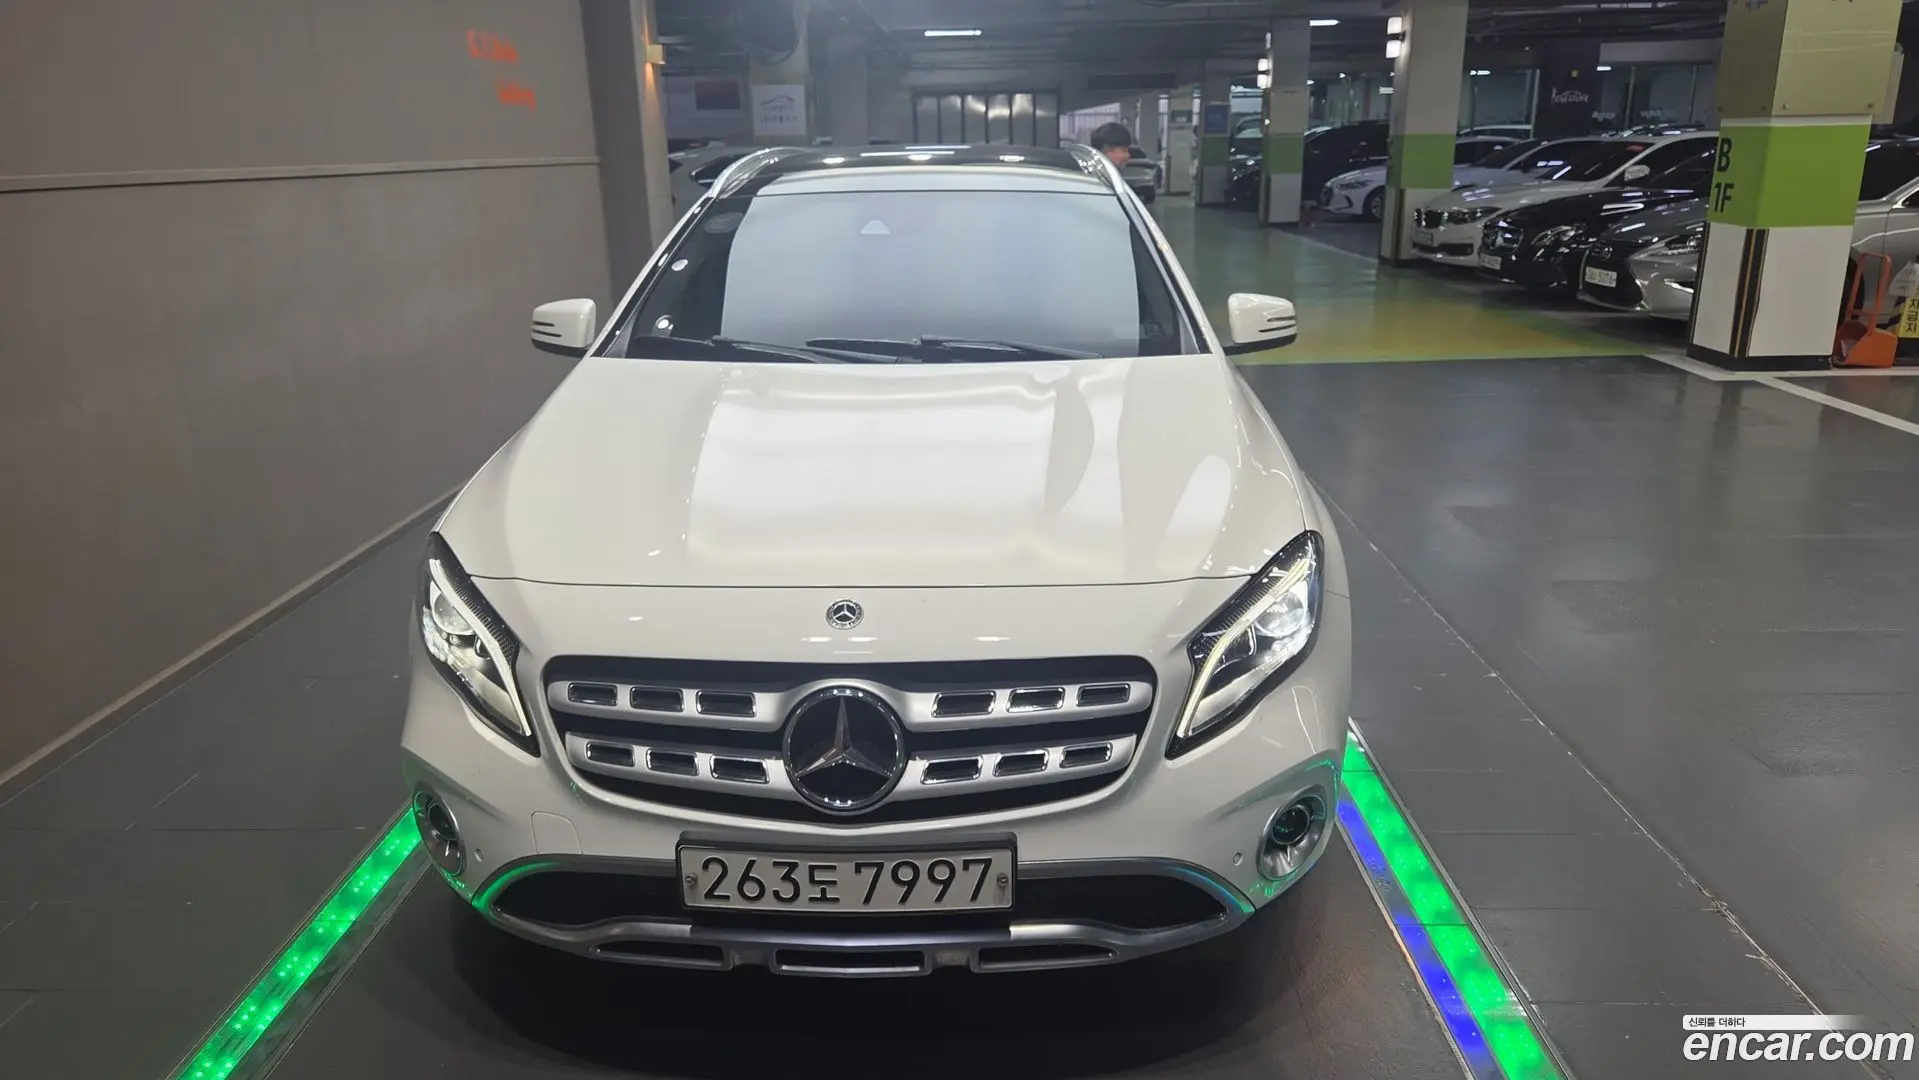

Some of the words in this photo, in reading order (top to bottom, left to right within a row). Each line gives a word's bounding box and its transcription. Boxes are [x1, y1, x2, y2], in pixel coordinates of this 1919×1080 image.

[1716, 137, 1733, 172] B
[1713, 182, 1735, 214] 1F
[701, 856, 840, 904] 263도
[854, 857, 993, 905] 7997
